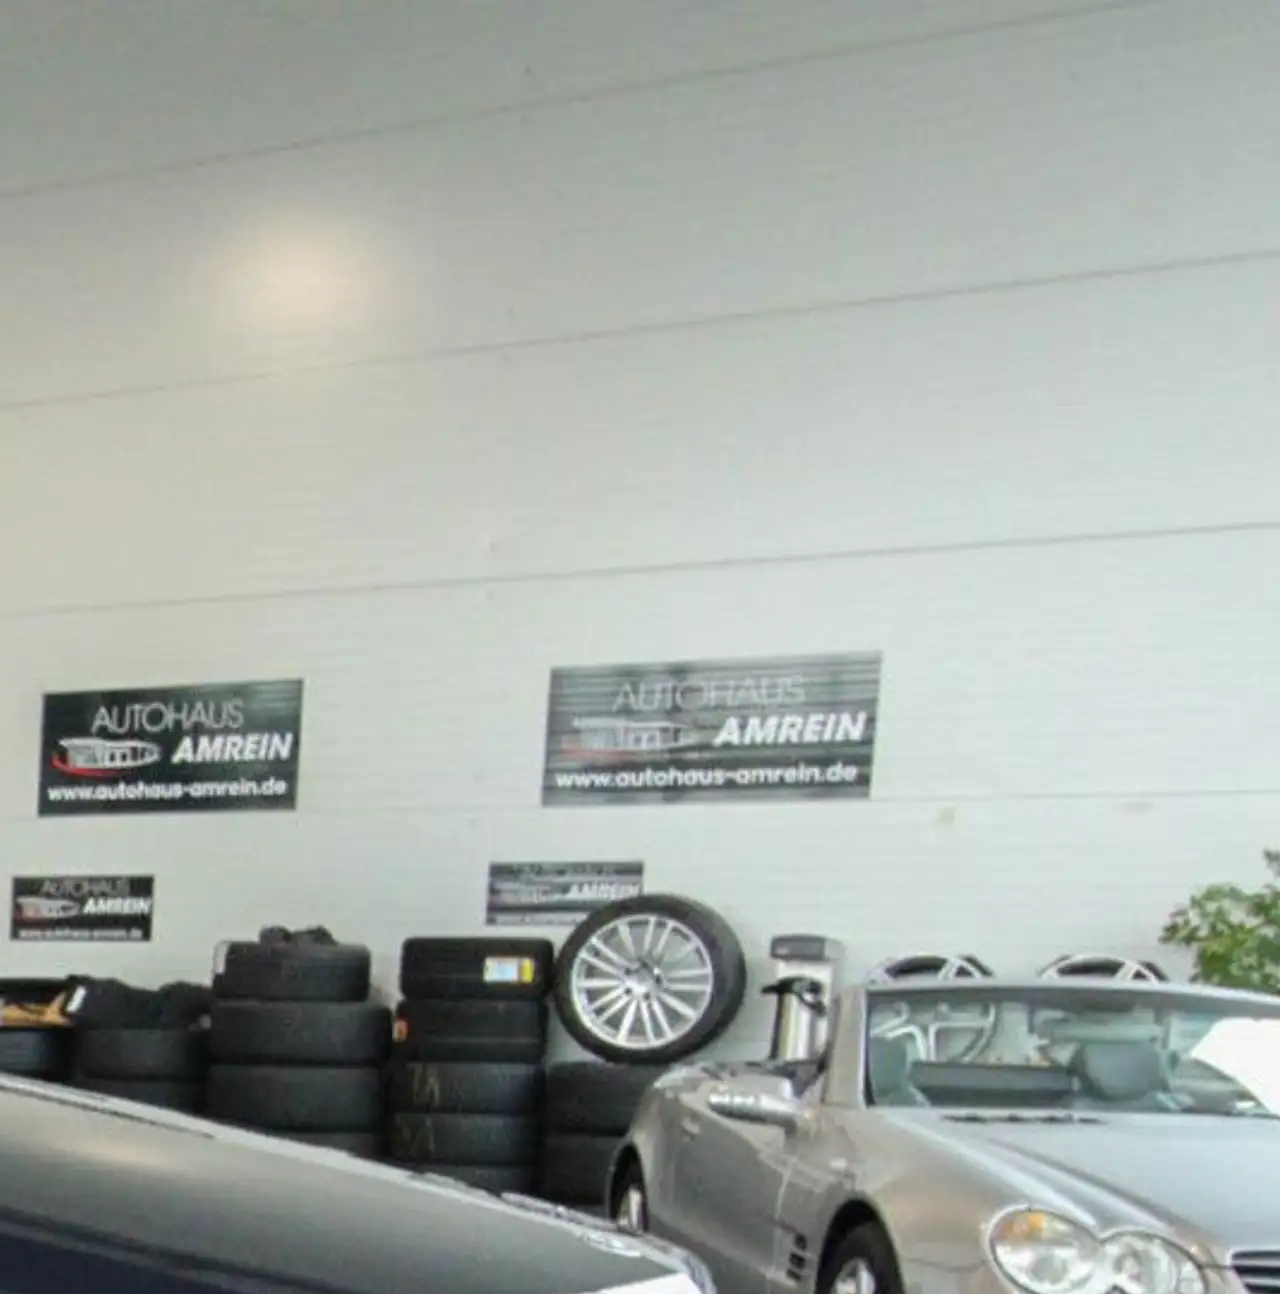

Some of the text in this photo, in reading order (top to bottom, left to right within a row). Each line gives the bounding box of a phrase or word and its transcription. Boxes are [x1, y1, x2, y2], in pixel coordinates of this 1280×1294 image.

[611, 674, 806, 713] AUTOHAUS
[90, 698, 245, 735] AUTOHAUS
[711, 711, 868, 748] AMREIN
[170, 732, 294, 765] AMREIN
[46, 776, 288, 801] www.autohaus-amrein.de
[553, 762, 858, 790] www.autohaus-amrein.de
